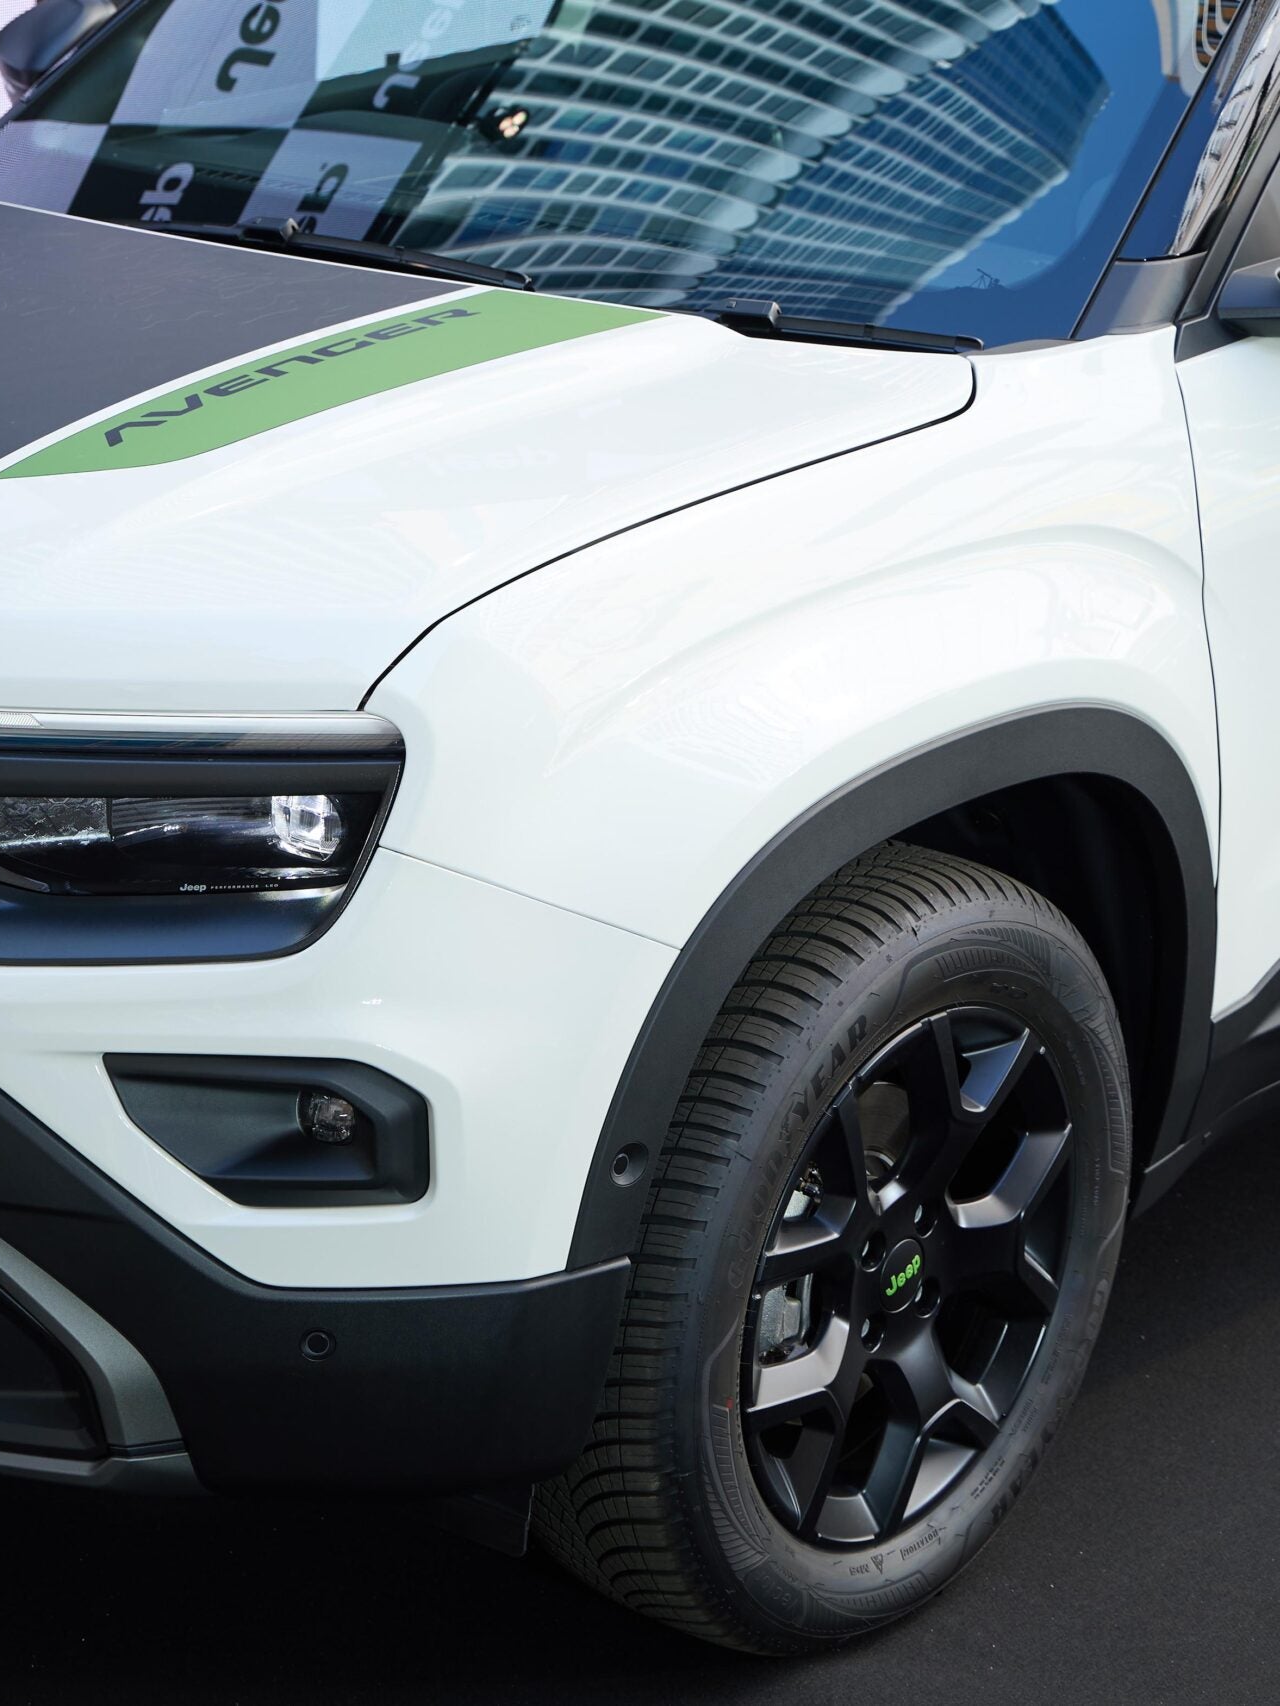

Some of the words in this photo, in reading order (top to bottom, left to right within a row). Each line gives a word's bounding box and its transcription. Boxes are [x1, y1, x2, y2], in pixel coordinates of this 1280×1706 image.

[104, 307, 482, 447] AVENGER
[179, 883, 207, 892] Jeep
[885, 1254, 921, 1296] Jeep
